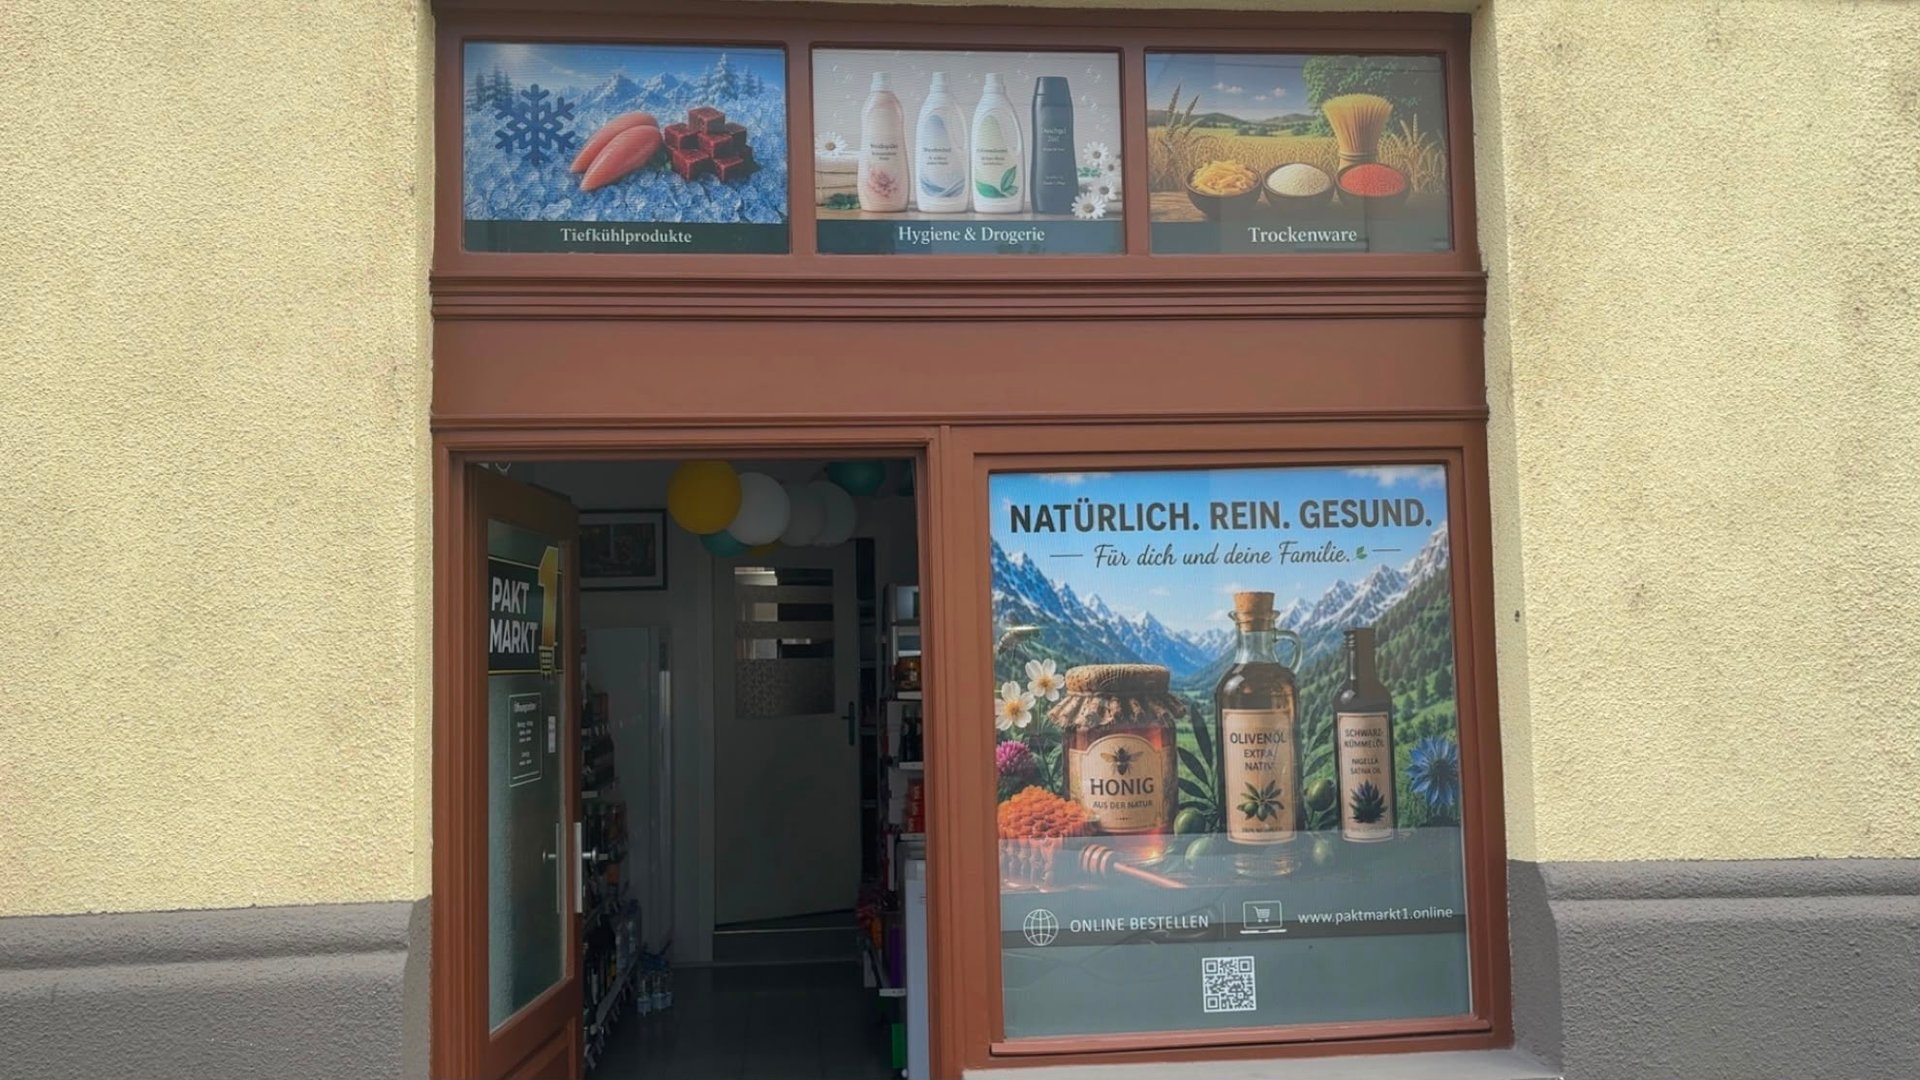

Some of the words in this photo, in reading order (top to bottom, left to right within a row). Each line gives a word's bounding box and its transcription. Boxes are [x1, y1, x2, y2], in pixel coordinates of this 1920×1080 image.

[559, 227, 692, 245] Tiefkühlprodukte
[898, 226, 961, 244] Hygiene
[964, 226, 976, 241] &
[981, 226, 1045, 244] Drogerie
[1247, 226, 1358, 242] Trockenware
[1010, 496, 1200, 533] NATÜRLICH.
[1210, 500, 1290, 530] REIN.
[1299, 497, 1433, 529] GESUND.
[1094, 543, 1130, 569] Für
[1137, 542, 1178, 567] dich
[1182, 542, 1219, 566] und
[1223, 543, 1272, 565] deine
[1278, 540, 1351, 565] Familie.
[491, 576, 530, 615] PAKT
[489, 618, 539, 654] MARKT
[1229, 730, 1287, 745] OLIVENÖL
[1243, 748, 1274, 759] EXTRA
[1244, 761, 1275, 772] NATIV
[1089, 777, 1155, 797] HONIG
[1093, 800, 1108, 810] AUS
[1109, 800, 1127, 811] DER
[1069, 917, 1125, 934] ONLINE
[1129, 914, 1209, 931] BESTELLEN
[1298, 905, 1454, 926] www.paktmarkt1.online
